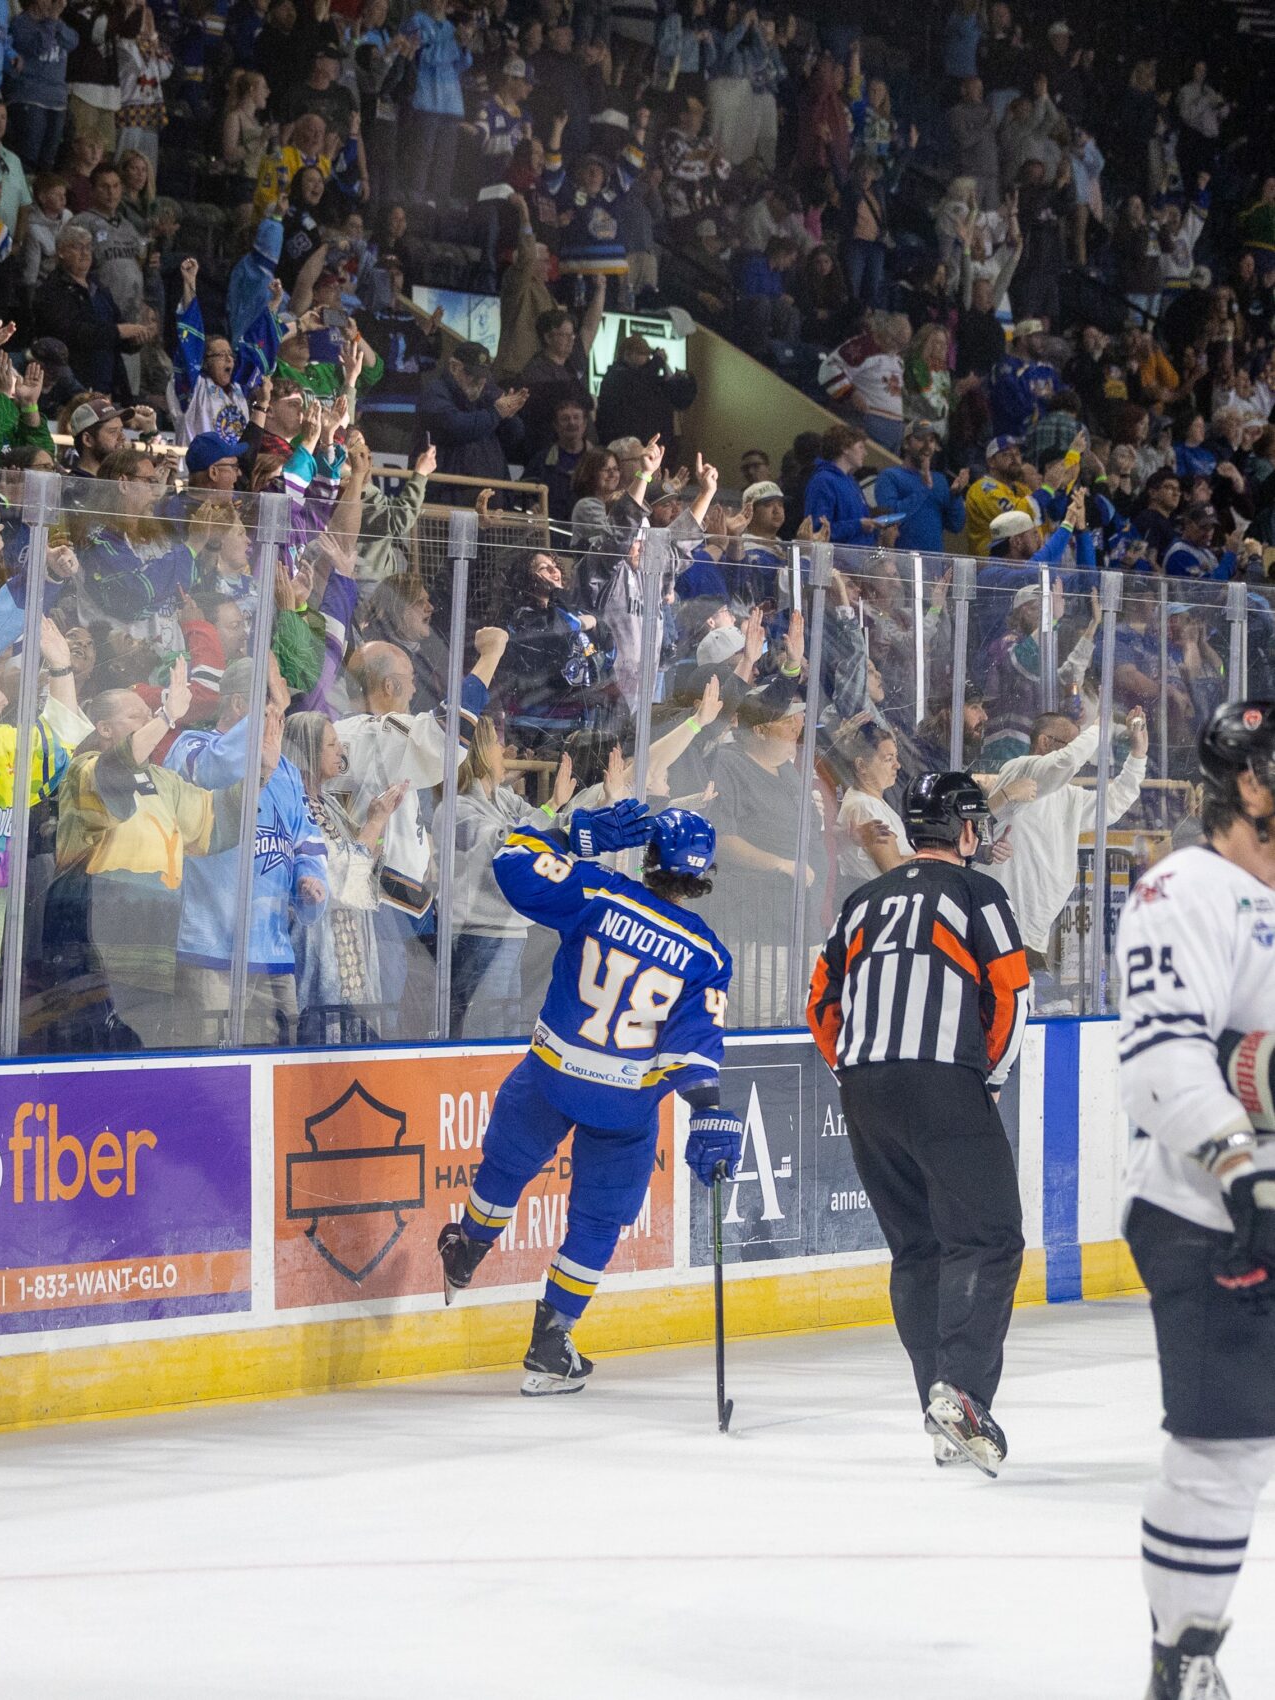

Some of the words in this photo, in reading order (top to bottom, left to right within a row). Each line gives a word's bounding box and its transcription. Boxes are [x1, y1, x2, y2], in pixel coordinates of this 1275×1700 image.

[687, 855, 707, 869] 48
[598, 908, 693, 972] NOVOTNY
[872, 892, 925, 953] 21
[578, 936, 685, 1050] 48
[1127, 945, 1186, 997] 24
[439, 1090, 499, 1152] ROA
[18, 1263, 179, 1301] 1-833-WANT-GLO
